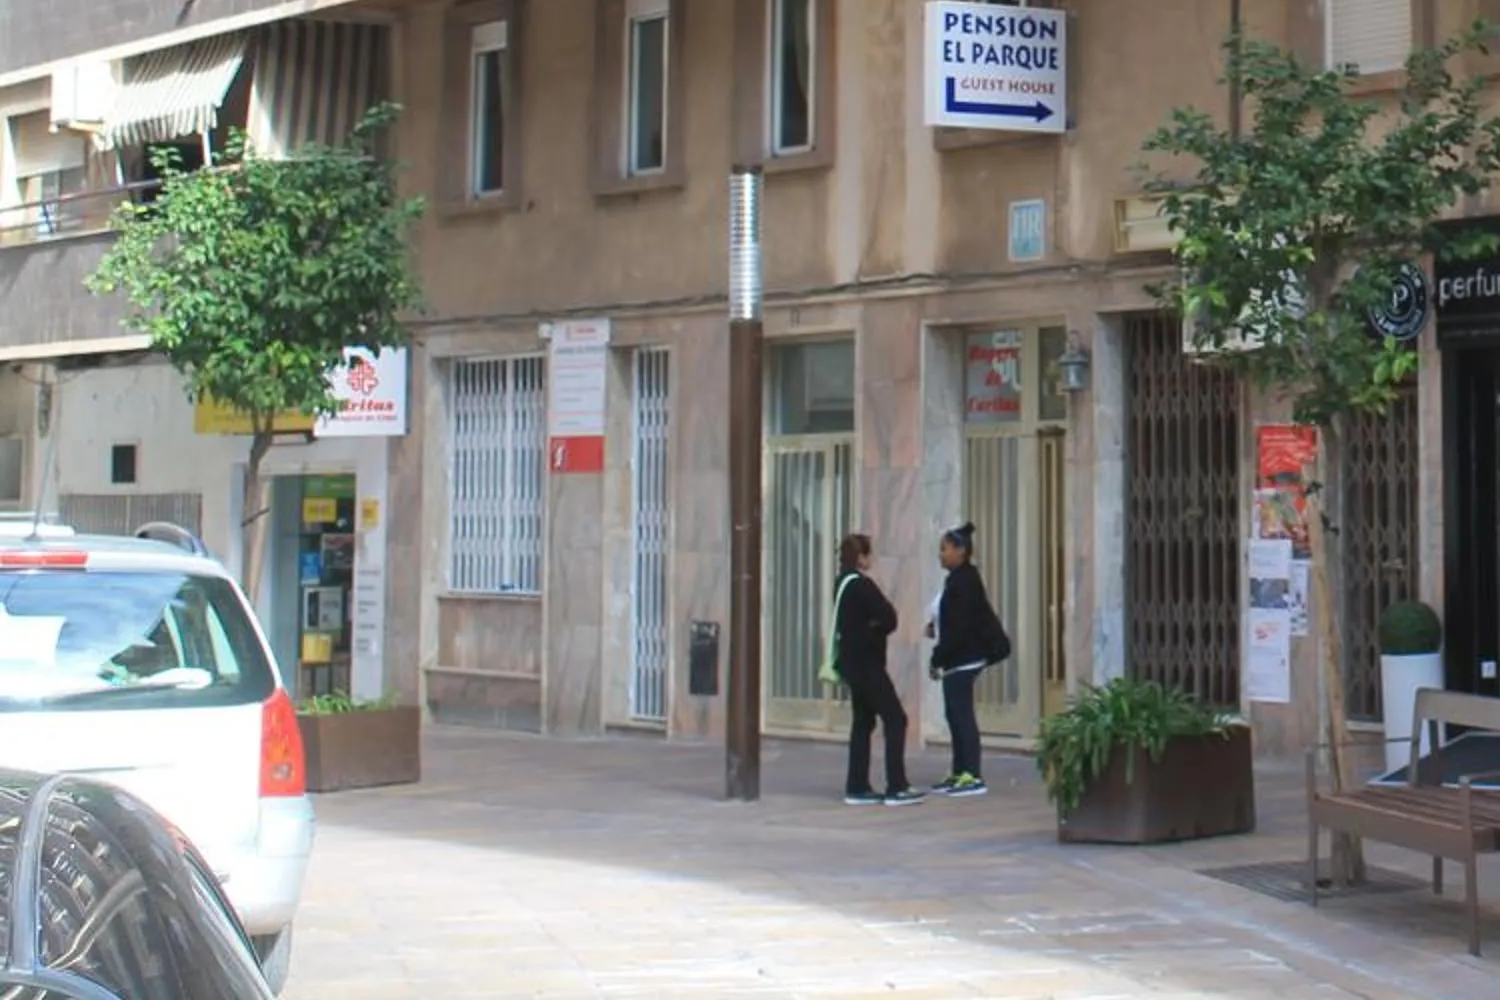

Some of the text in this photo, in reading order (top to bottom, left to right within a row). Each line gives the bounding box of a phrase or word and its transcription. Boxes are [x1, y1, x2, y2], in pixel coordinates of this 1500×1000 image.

[944, 12, 1057, 39] PENSIÓN
[943, 40, 1059, 70] EL PARQUE
[960, 78, 1056, 95] GUEST HOUSE
